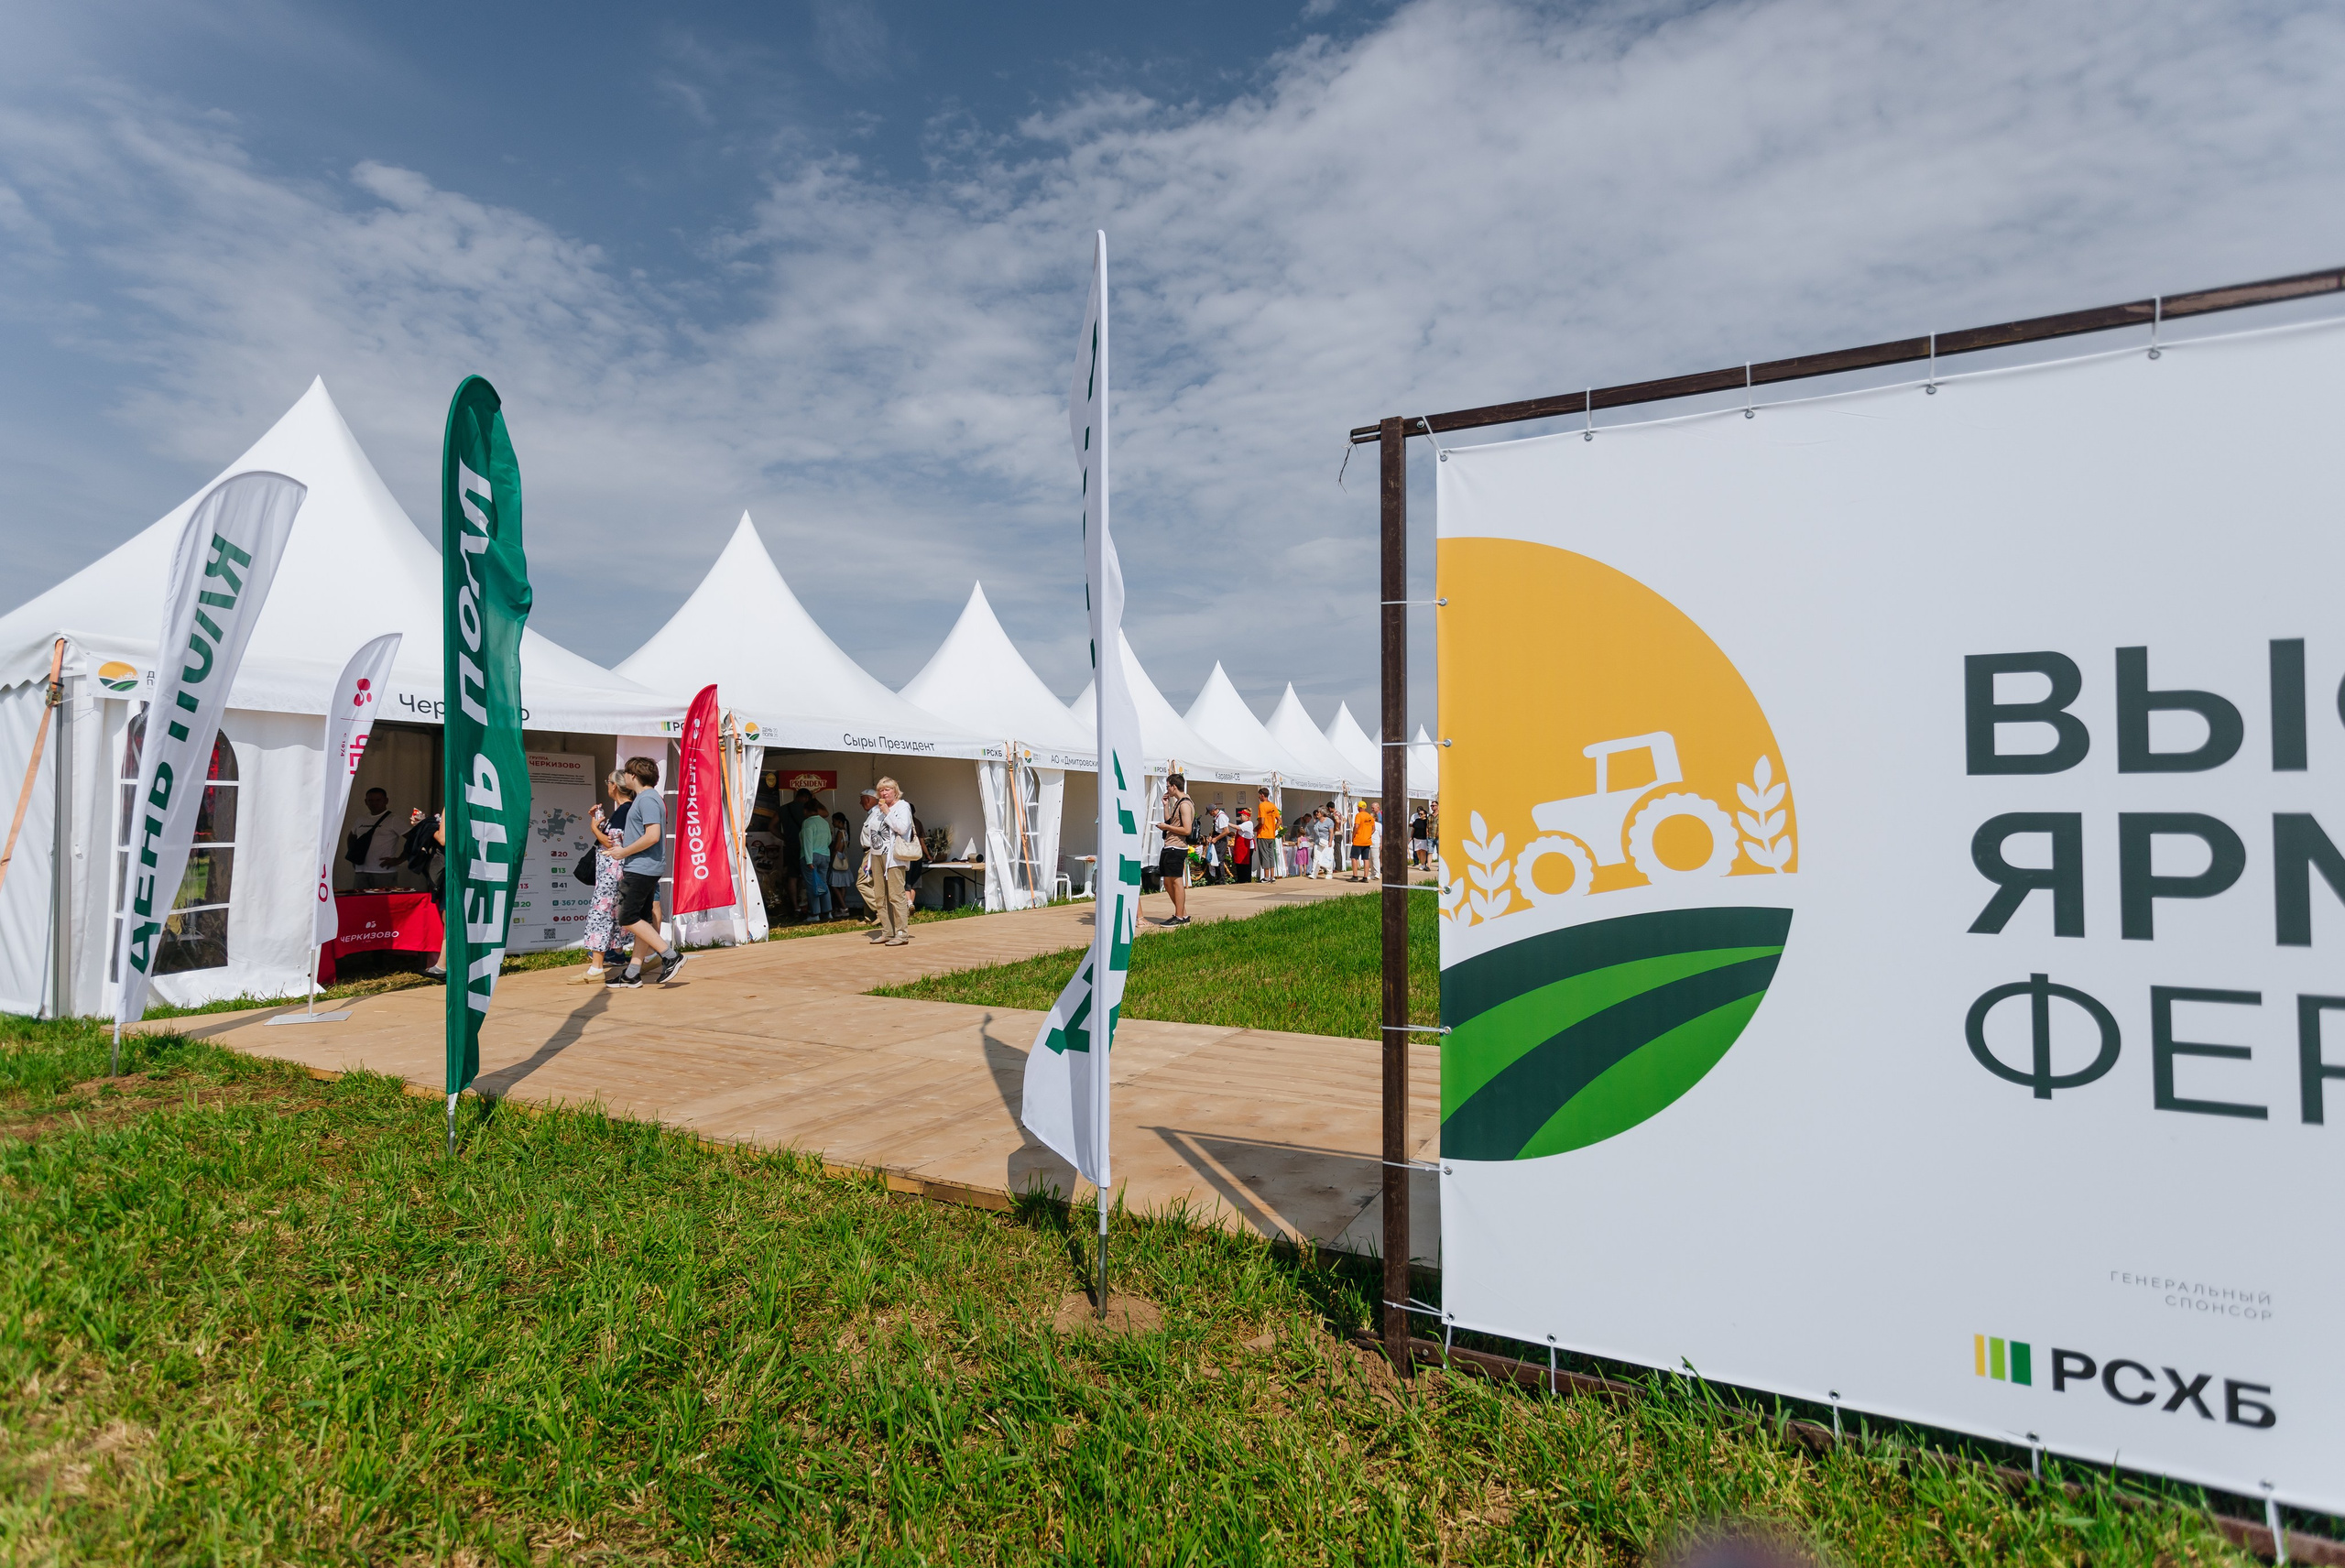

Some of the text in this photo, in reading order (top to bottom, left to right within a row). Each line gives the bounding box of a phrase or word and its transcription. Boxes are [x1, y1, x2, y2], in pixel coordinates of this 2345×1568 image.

[1964, 638, 2345, 776] ВЫ
[844, 733, 935, 752] Сыры Президент
[986, 749, 1002, 757] РСХБ
[1052, 755, 1060, 764] АО
[1061, 756, 1098, 768] «Дмитровски
[529, 760, 581, 769] ЧЕРКИЗОВО
[791, 779, 826, 788] PRÉSIDENT
[464, 753, 508, 1014] ДЕНЬ
[341, 931, 399, 943] ЧЕРКИЗОВО
[2110, 1270, 2272, 1305] ГЕНЕРАЛЬНЫЙ
[2165, 1294, 2273, 1321] СПОНСОР
[2051, 1347, 2276, 1429] РСХБ
